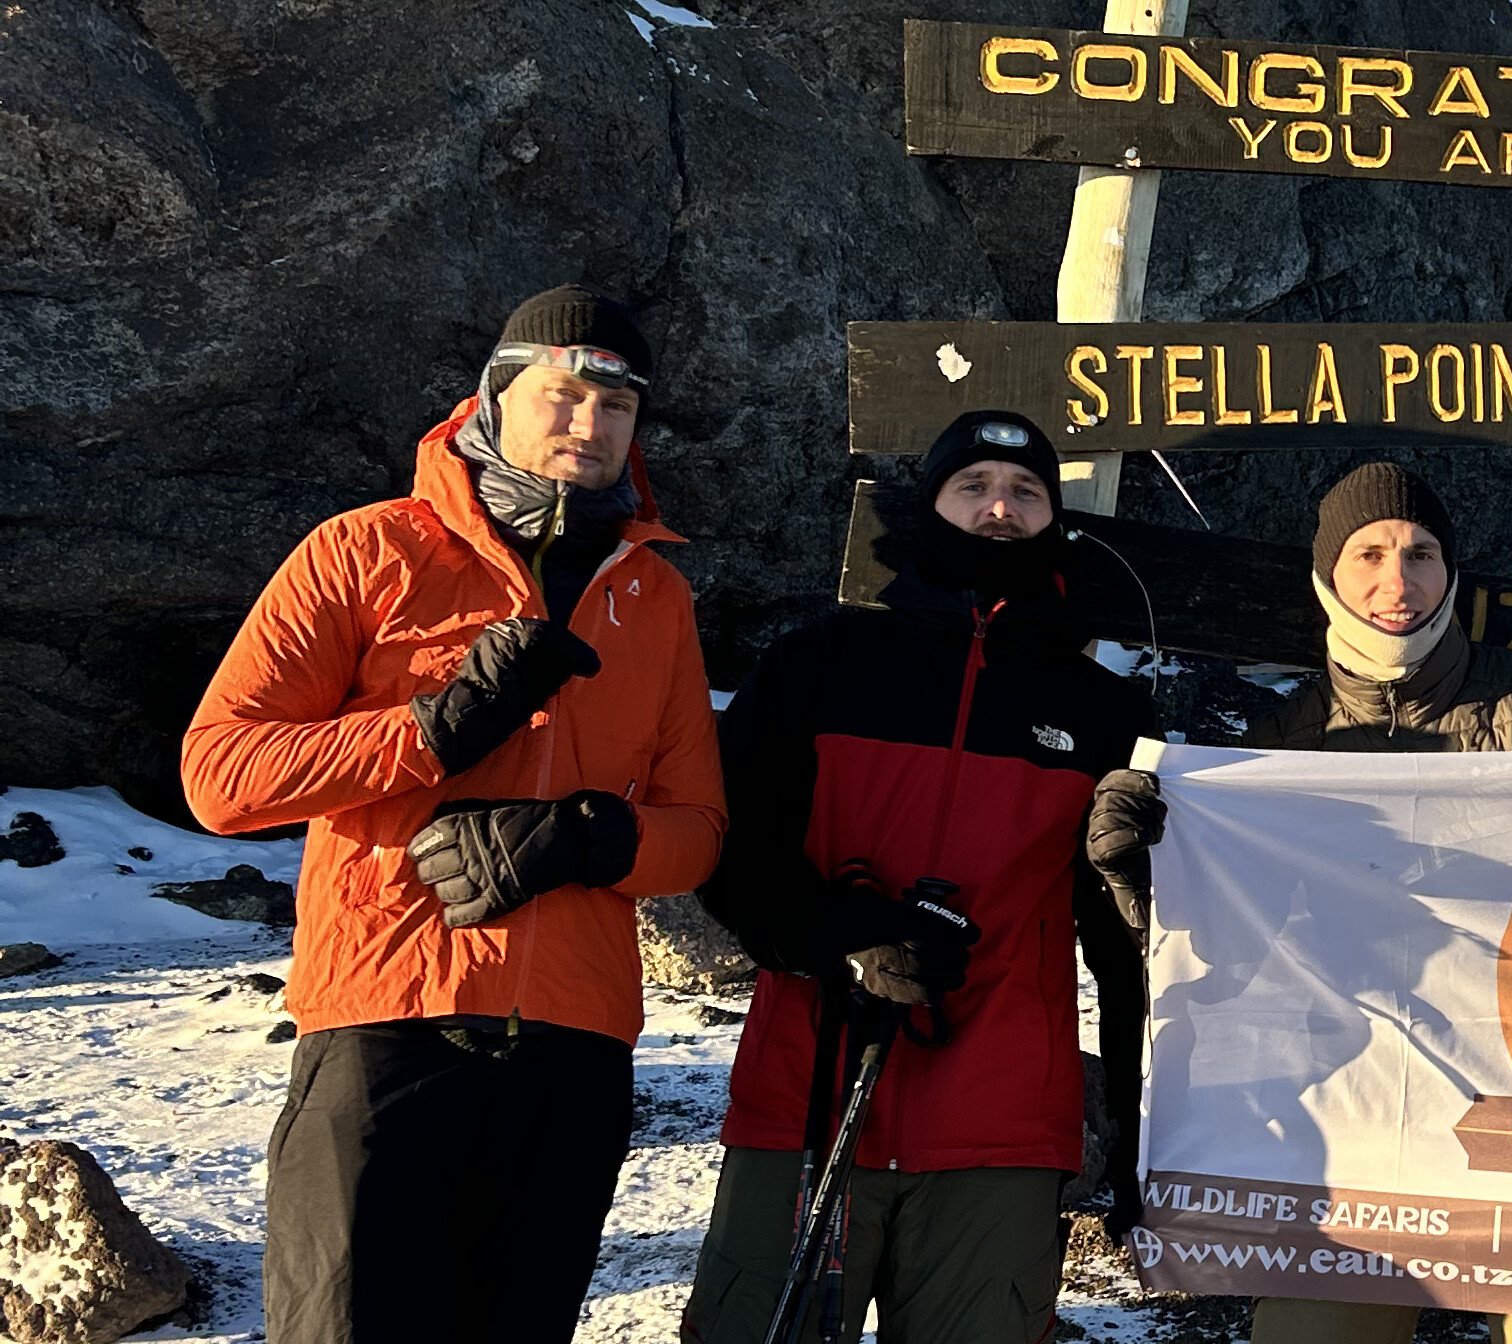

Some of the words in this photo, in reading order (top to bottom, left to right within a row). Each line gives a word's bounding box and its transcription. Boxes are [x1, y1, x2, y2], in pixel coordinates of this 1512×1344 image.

[1228, 116, 1393, 169] YOU
[1066, 343, 1347, 427] STELLA
[1145, 1181, 1299, 1222] WILDLIFE
[1309, 1198, 1450, 1236] SAFARIS
